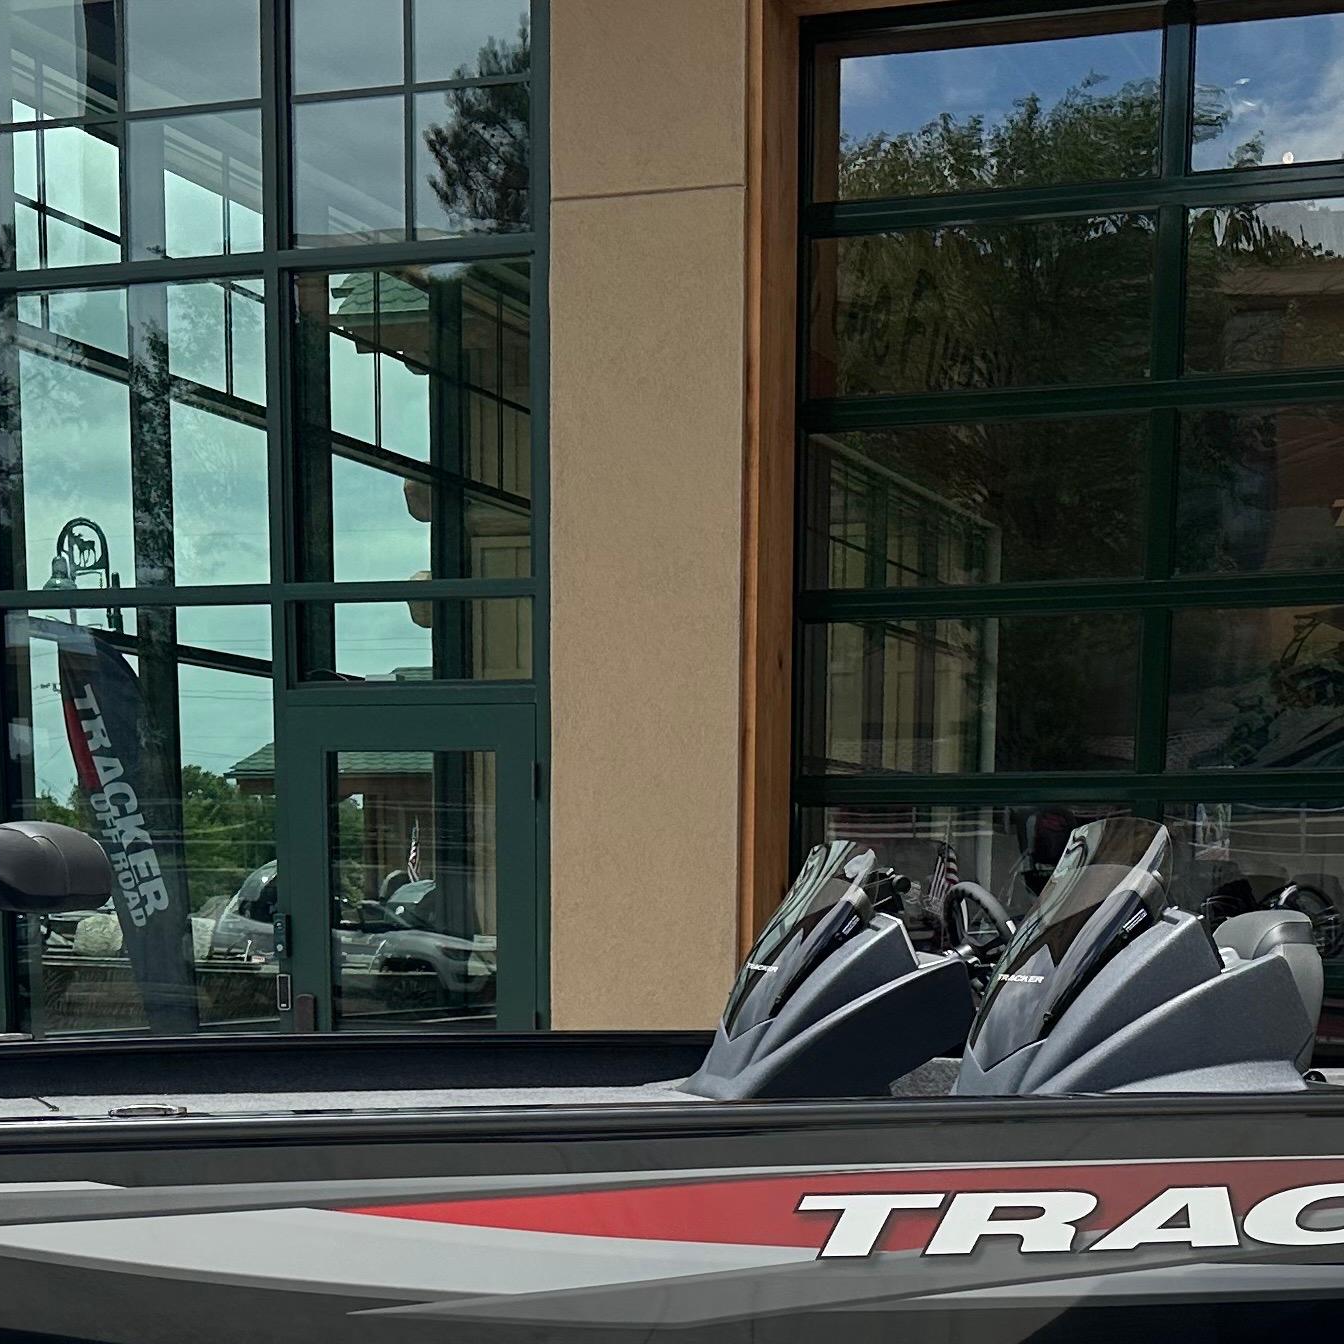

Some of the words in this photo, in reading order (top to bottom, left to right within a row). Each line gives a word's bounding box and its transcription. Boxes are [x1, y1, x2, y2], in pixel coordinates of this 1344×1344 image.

[74, 683, 169, 917] TRACKER
[90, 792, 120, 844] OFF
[110, 851, 147, 927] ROAD
[997, 974, 1045, 984] TRACKER
